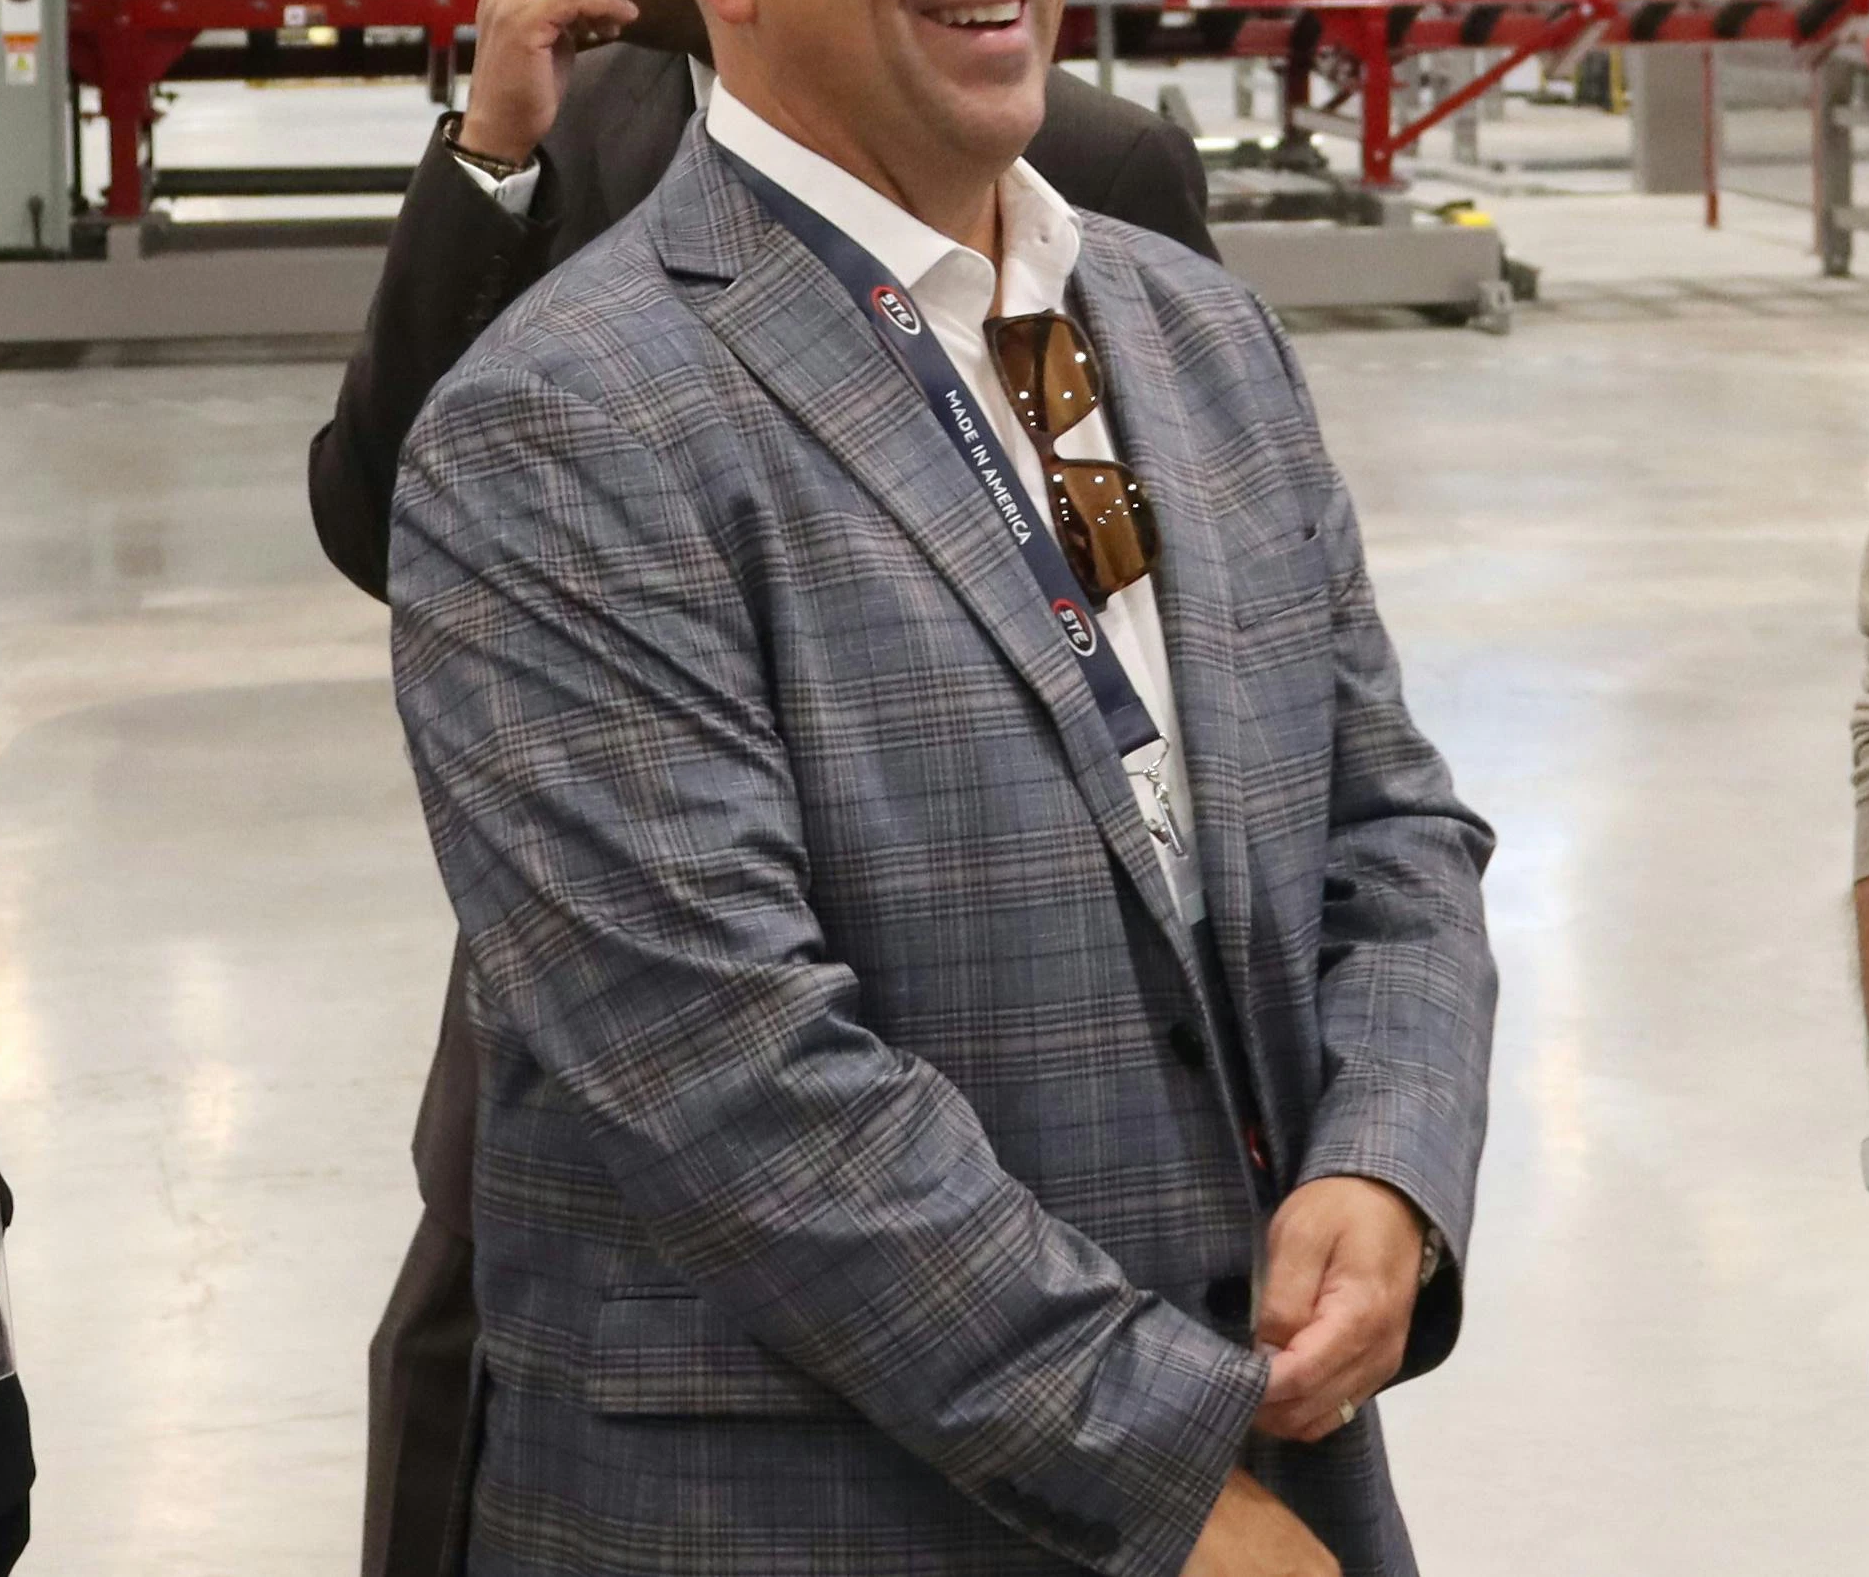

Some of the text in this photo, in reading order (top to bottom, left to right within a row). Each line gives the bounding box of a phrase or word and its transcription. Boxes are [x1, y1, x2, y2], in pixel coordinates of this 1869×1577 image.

[880, 293, 914, 325] STE
[945, 389, 1032, 546] MADE IN AMERICA
[1059, 609, 1090, 645] STE
